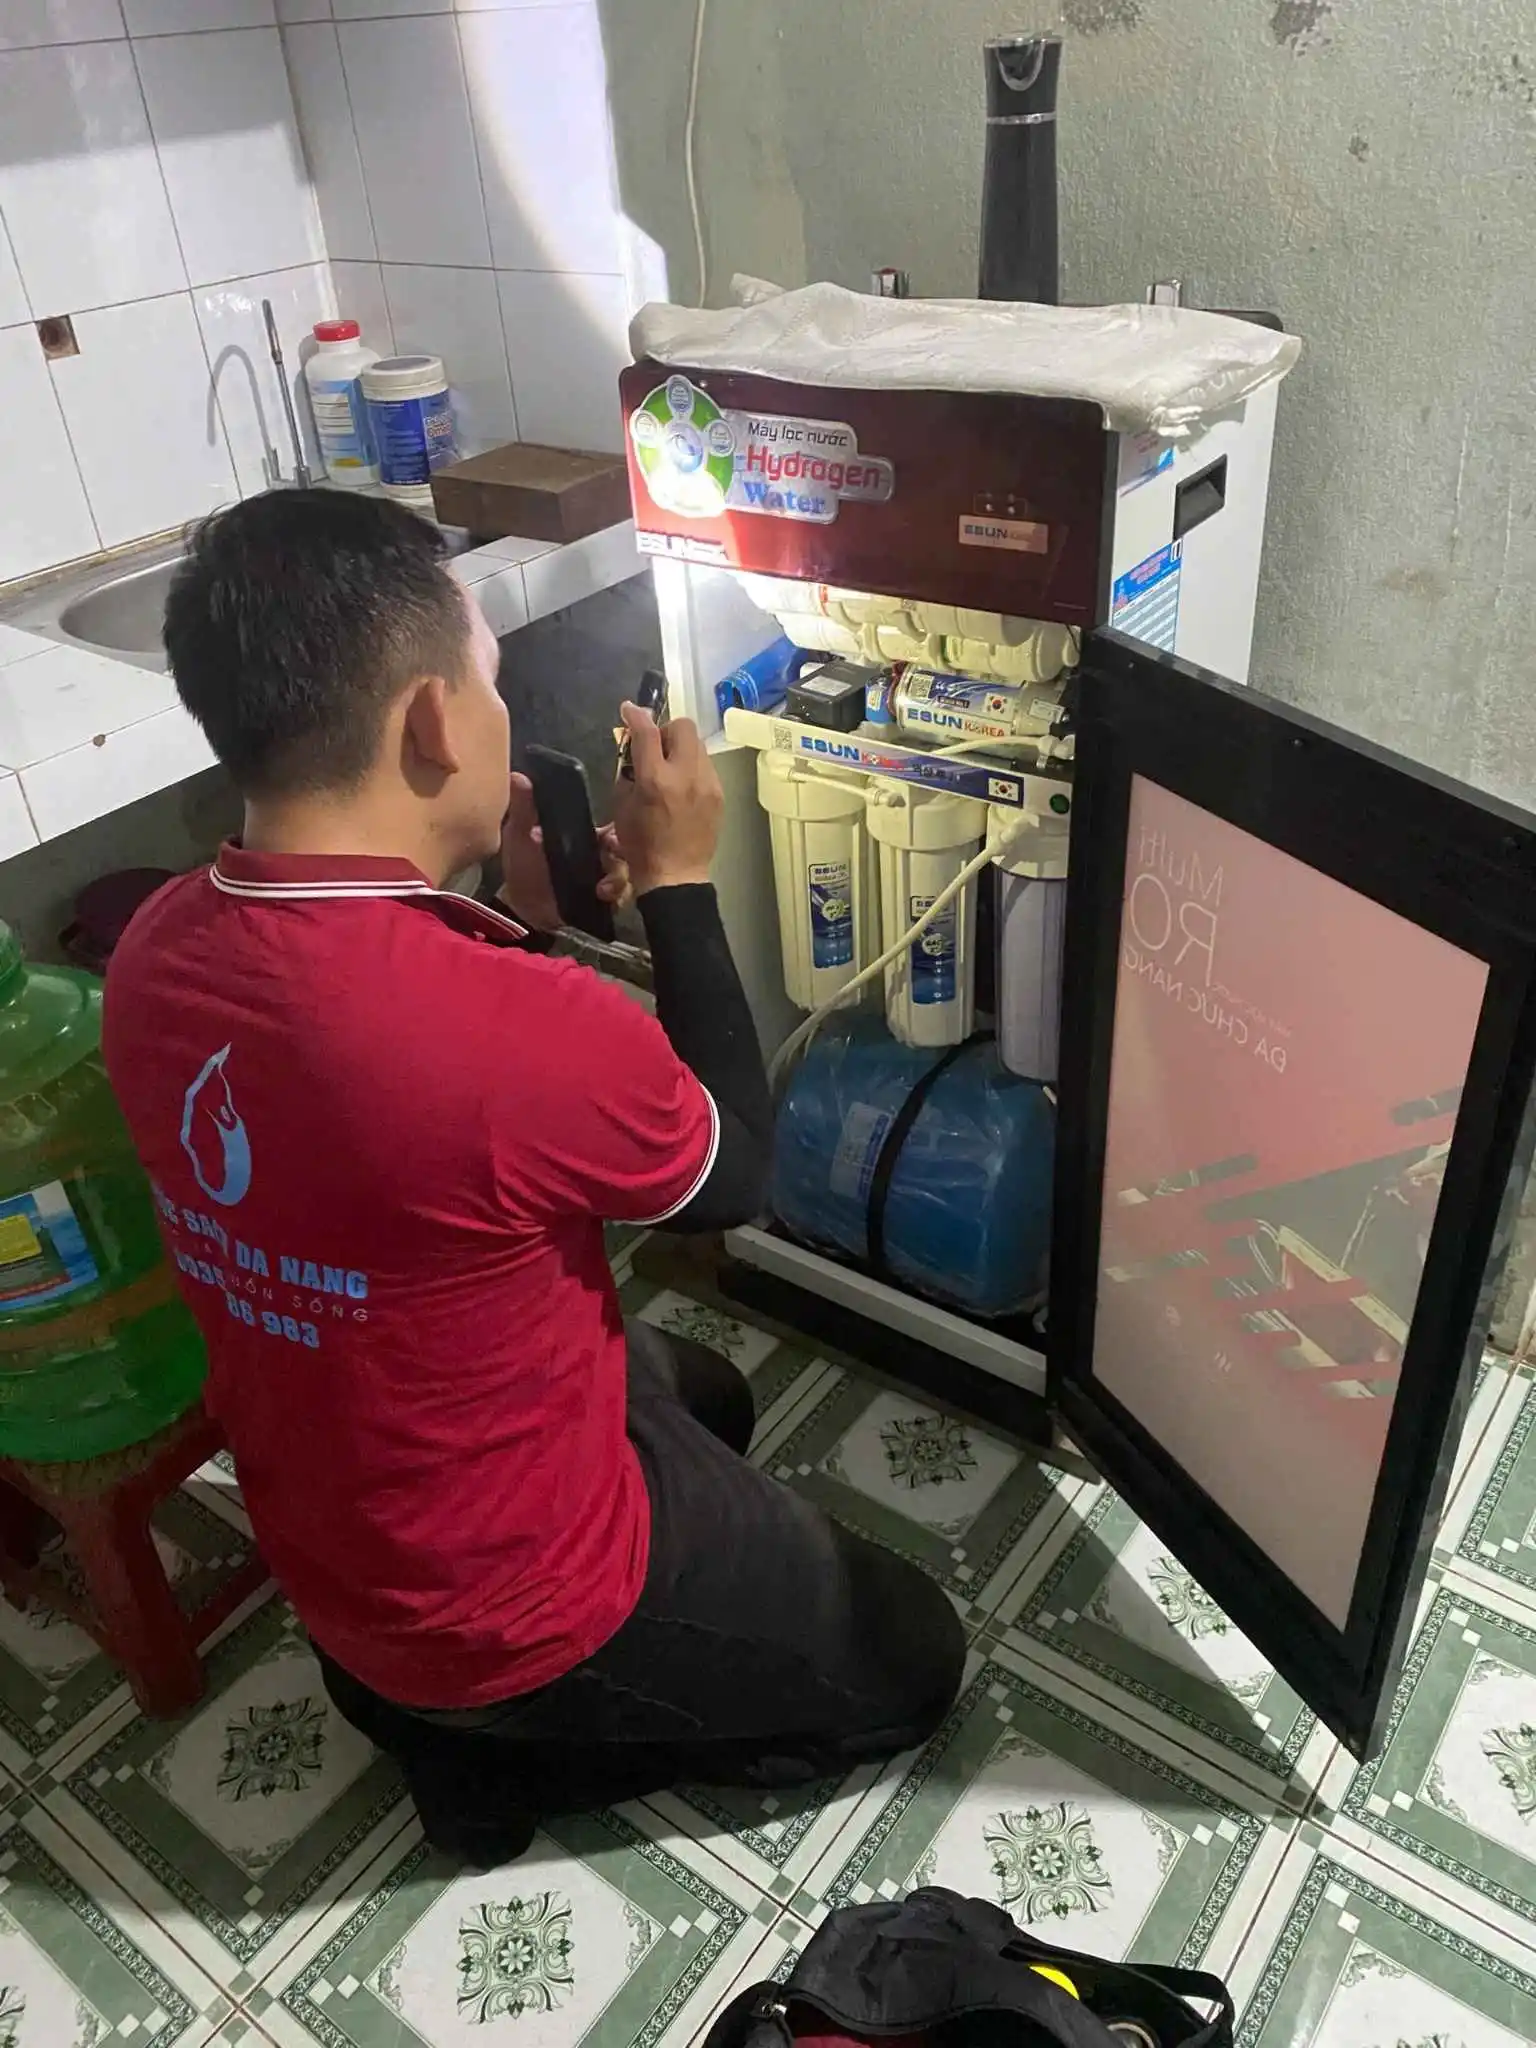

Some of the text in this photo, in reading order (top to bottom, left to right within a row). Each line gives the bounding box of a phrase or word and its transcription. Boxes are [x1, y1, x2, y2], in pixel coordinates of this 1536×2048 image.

[748, 422, 778, 442] Máy
[782, 425, 803, 445] lọc
[807, 430, 848, 447] nước
[746, 445, 881, 490] Hydrogen
[743, 482, 825, 514] Water
[907, 708, 963, 730] ESUN
[964, 721, 1005, 737] KOREA
[801, 735, 860, 761] ESUN
[280, 1256, 368, 1300] NANG
